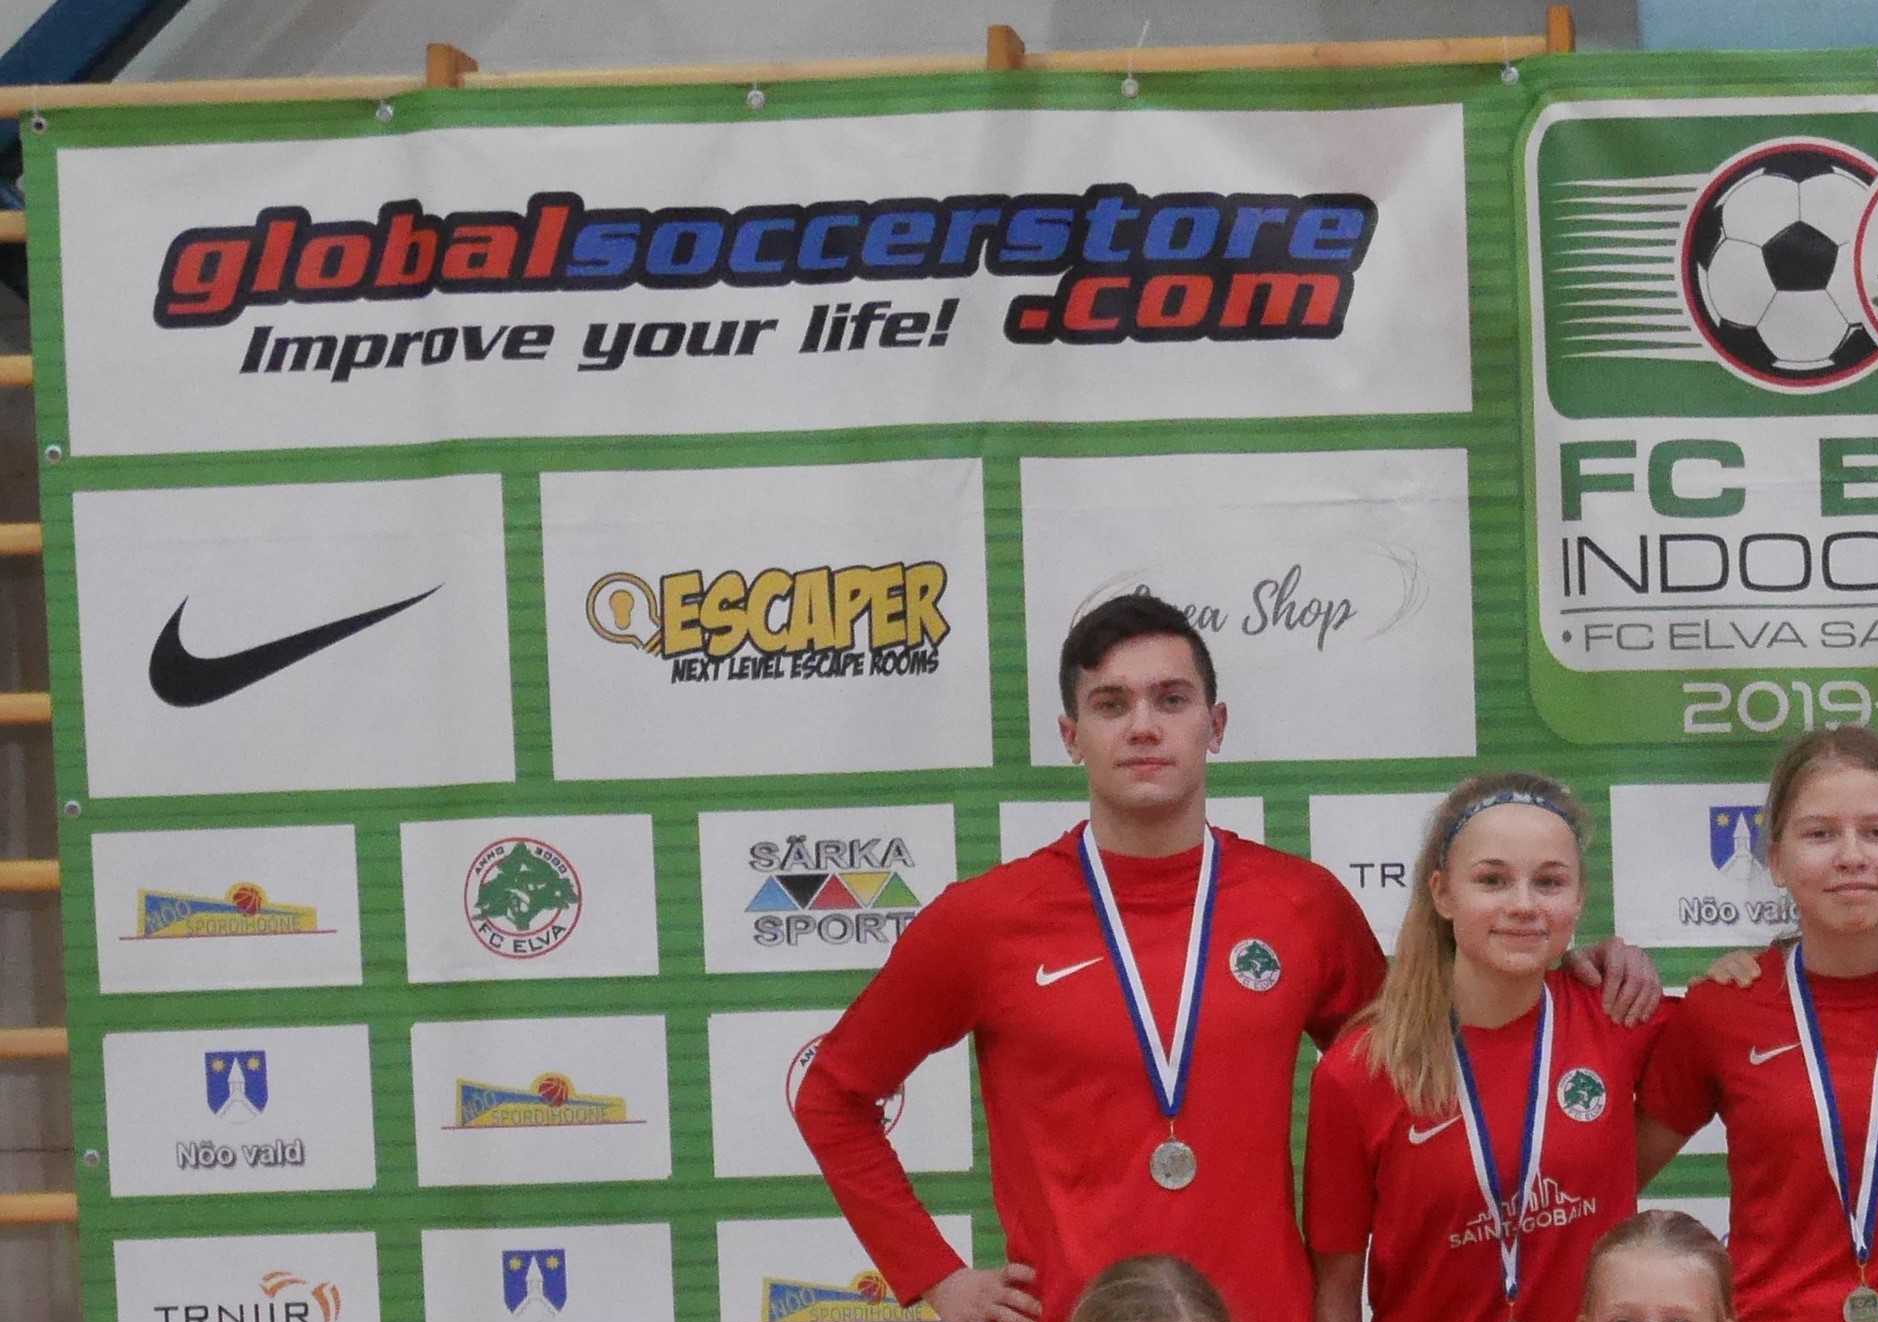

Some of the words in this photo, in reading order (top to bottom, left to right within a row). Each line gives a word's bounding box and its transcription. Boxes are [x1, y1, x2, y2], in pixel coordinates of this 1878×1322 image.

[154, 184, 1377, 328] globalsoccerstore
[1004, 270, 1354, 344] .com
[239, 324, 554, 382] Improve
[577, 318, 778, 372] your
[799, 298, 960, 353] life!
[1559, 438, 1747, 521] FC
[660, 560, 951, 660] ESCAPER
[1241, 564, 1357, 652] Shop
[1584, 624, 1654, 652] FC
[1669, 620, 1807, 651] ELVA
[671, 656, 724, 684] NEXT
[728, 655, 784, 681] LEVEL
[790, 652, 864, 678] ESCAPE
[869, 647, 940, 675] ROOMS
[475, 846, 504, 875] ANNO
[749, 835, 915, 871] SÄRKA
[1679, 895, 1737, 924] Nõo
[479, 923, 504, 948] FC
[513, 925, 567, 953] ELVA
[754, 912, 916, 946] SPORT
[176, 1141, 235, 1169] Nõo
[241, 1138, 306, 1167] vald
[1449, 1197, 1596, 1250] SAINT-GOBAIN
